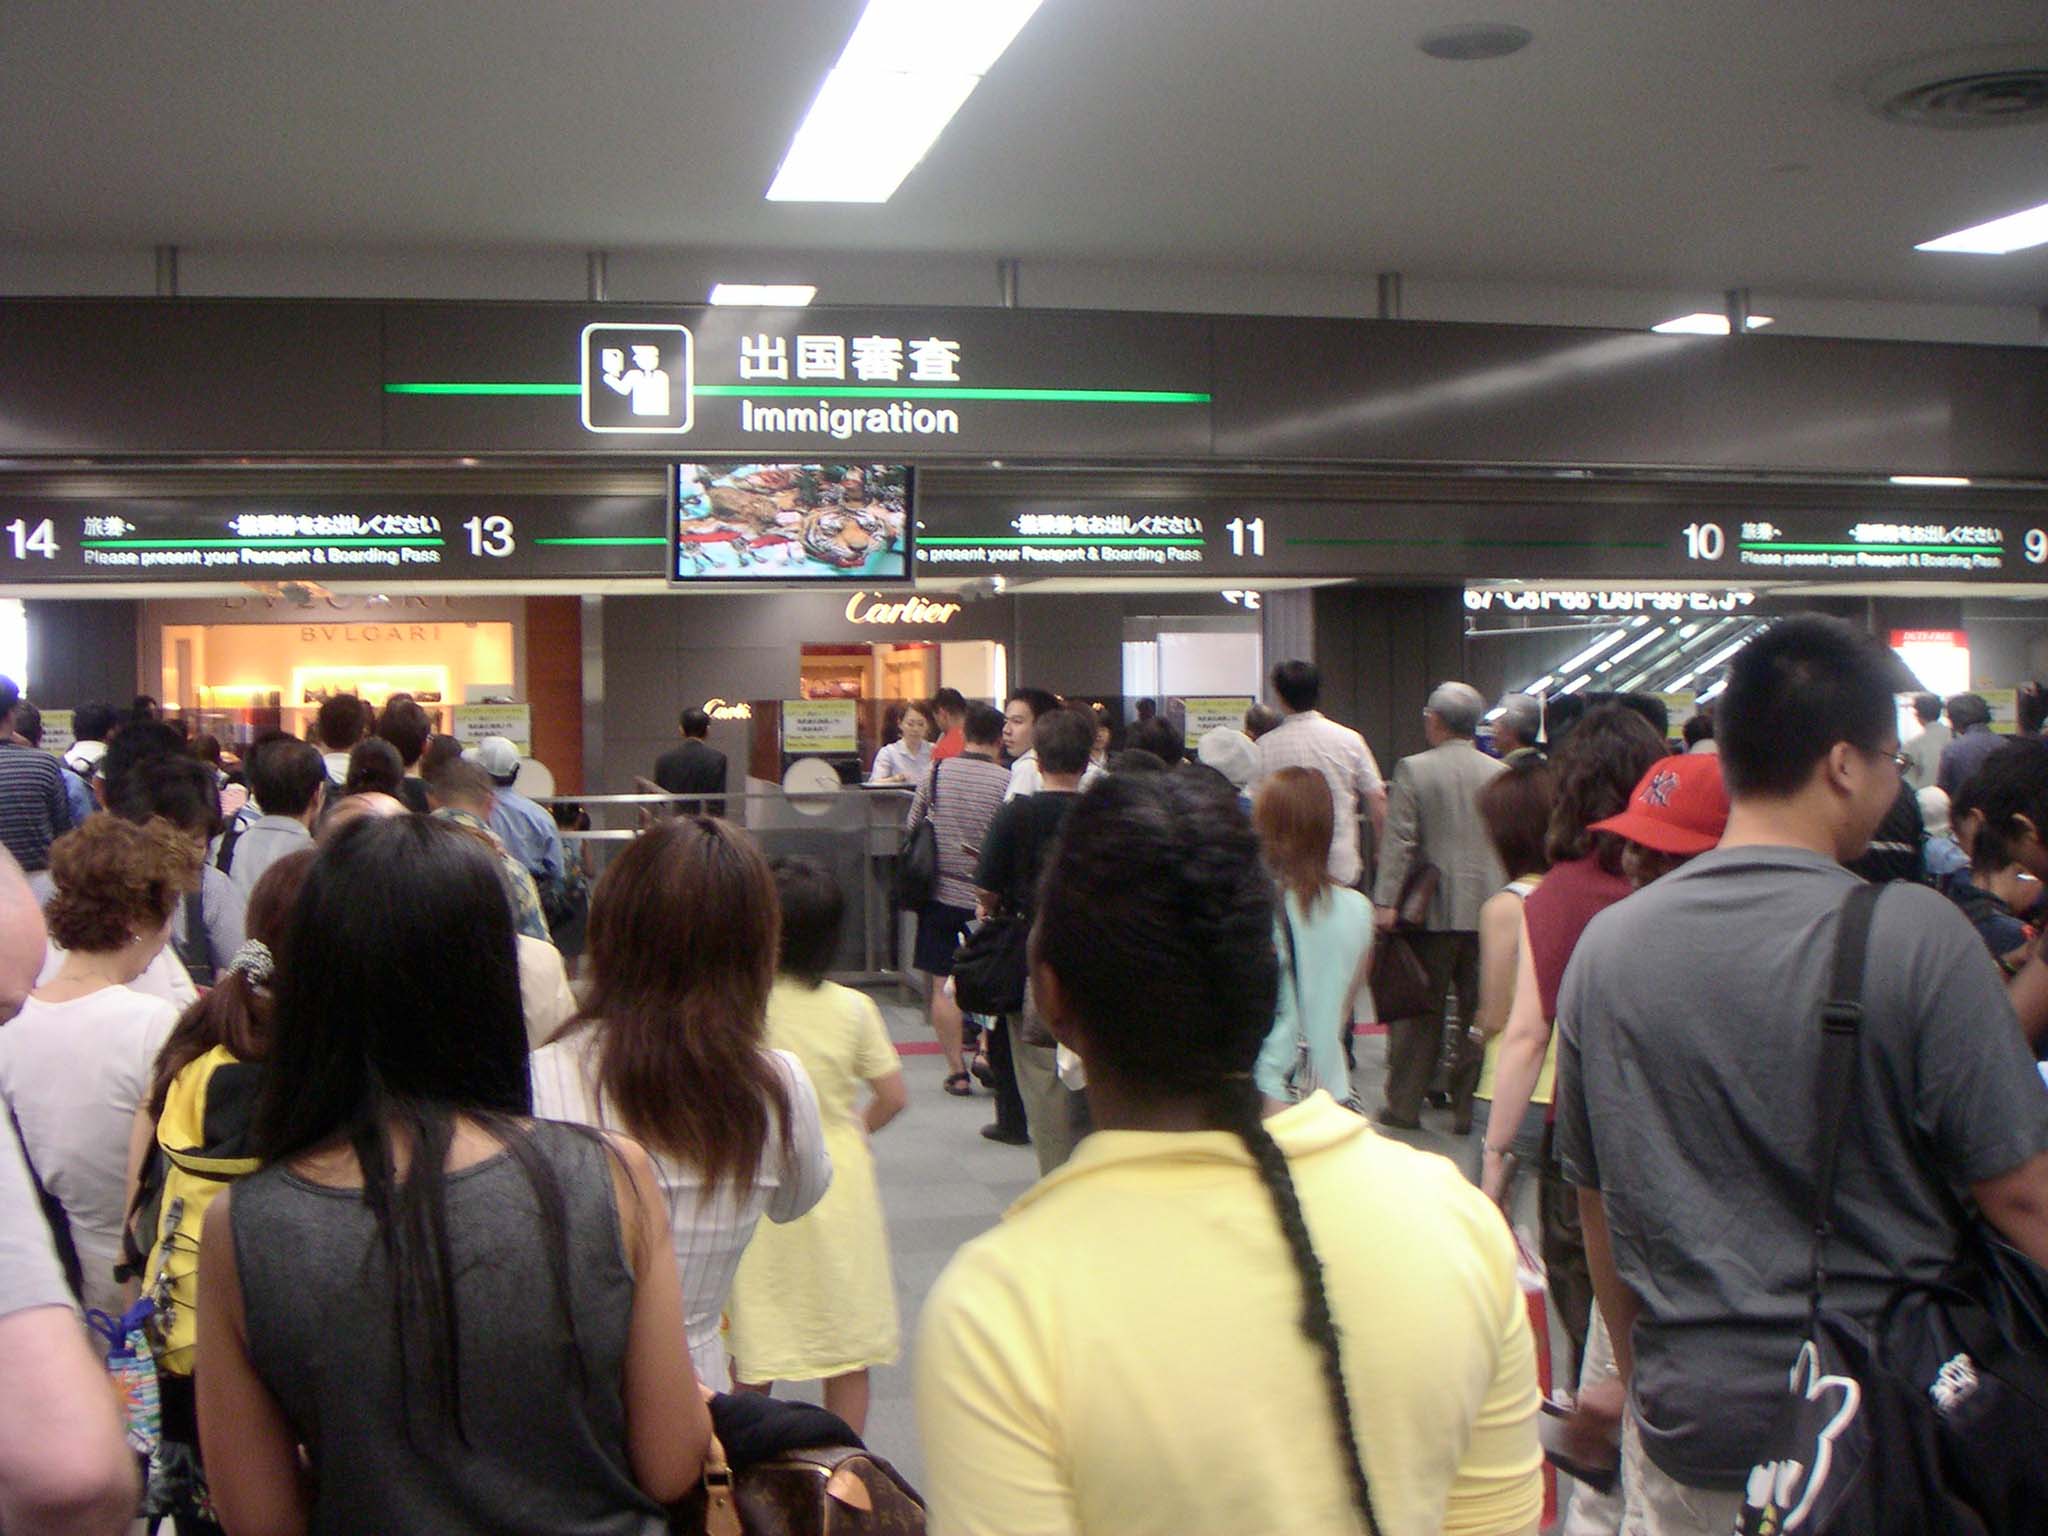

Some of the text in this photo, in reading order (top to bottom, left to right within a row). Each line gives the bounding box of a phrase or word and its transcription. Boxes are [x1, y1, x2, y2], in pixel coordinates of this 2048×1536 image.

[739, 334, 960, 381] 出国審査
[741, 399, 959, 439] Immigration
[5, 518, 61, 560] 14
[463, 515, 516, 558] 13
[929, 548, 987, 563] present
[988, 548, 1020, 564] your
[1021, 546, 1086, 564] Passport
[1086, 547, 1100, 562] &
[1101, 546, 1166, 564] Boarding
[1167, 547, 1203, 562] Pass
[1226, 517, 1265, 557] 11
[1682, 522, 1725, 560] 10
[2024, 528, 2048, 564] 9
[83, 547, 441, 567] Please present your Passport & Boarding Pass
[845, 591, 961, 624] Cartier
[301, 626, 440, 642] BVLGARI
